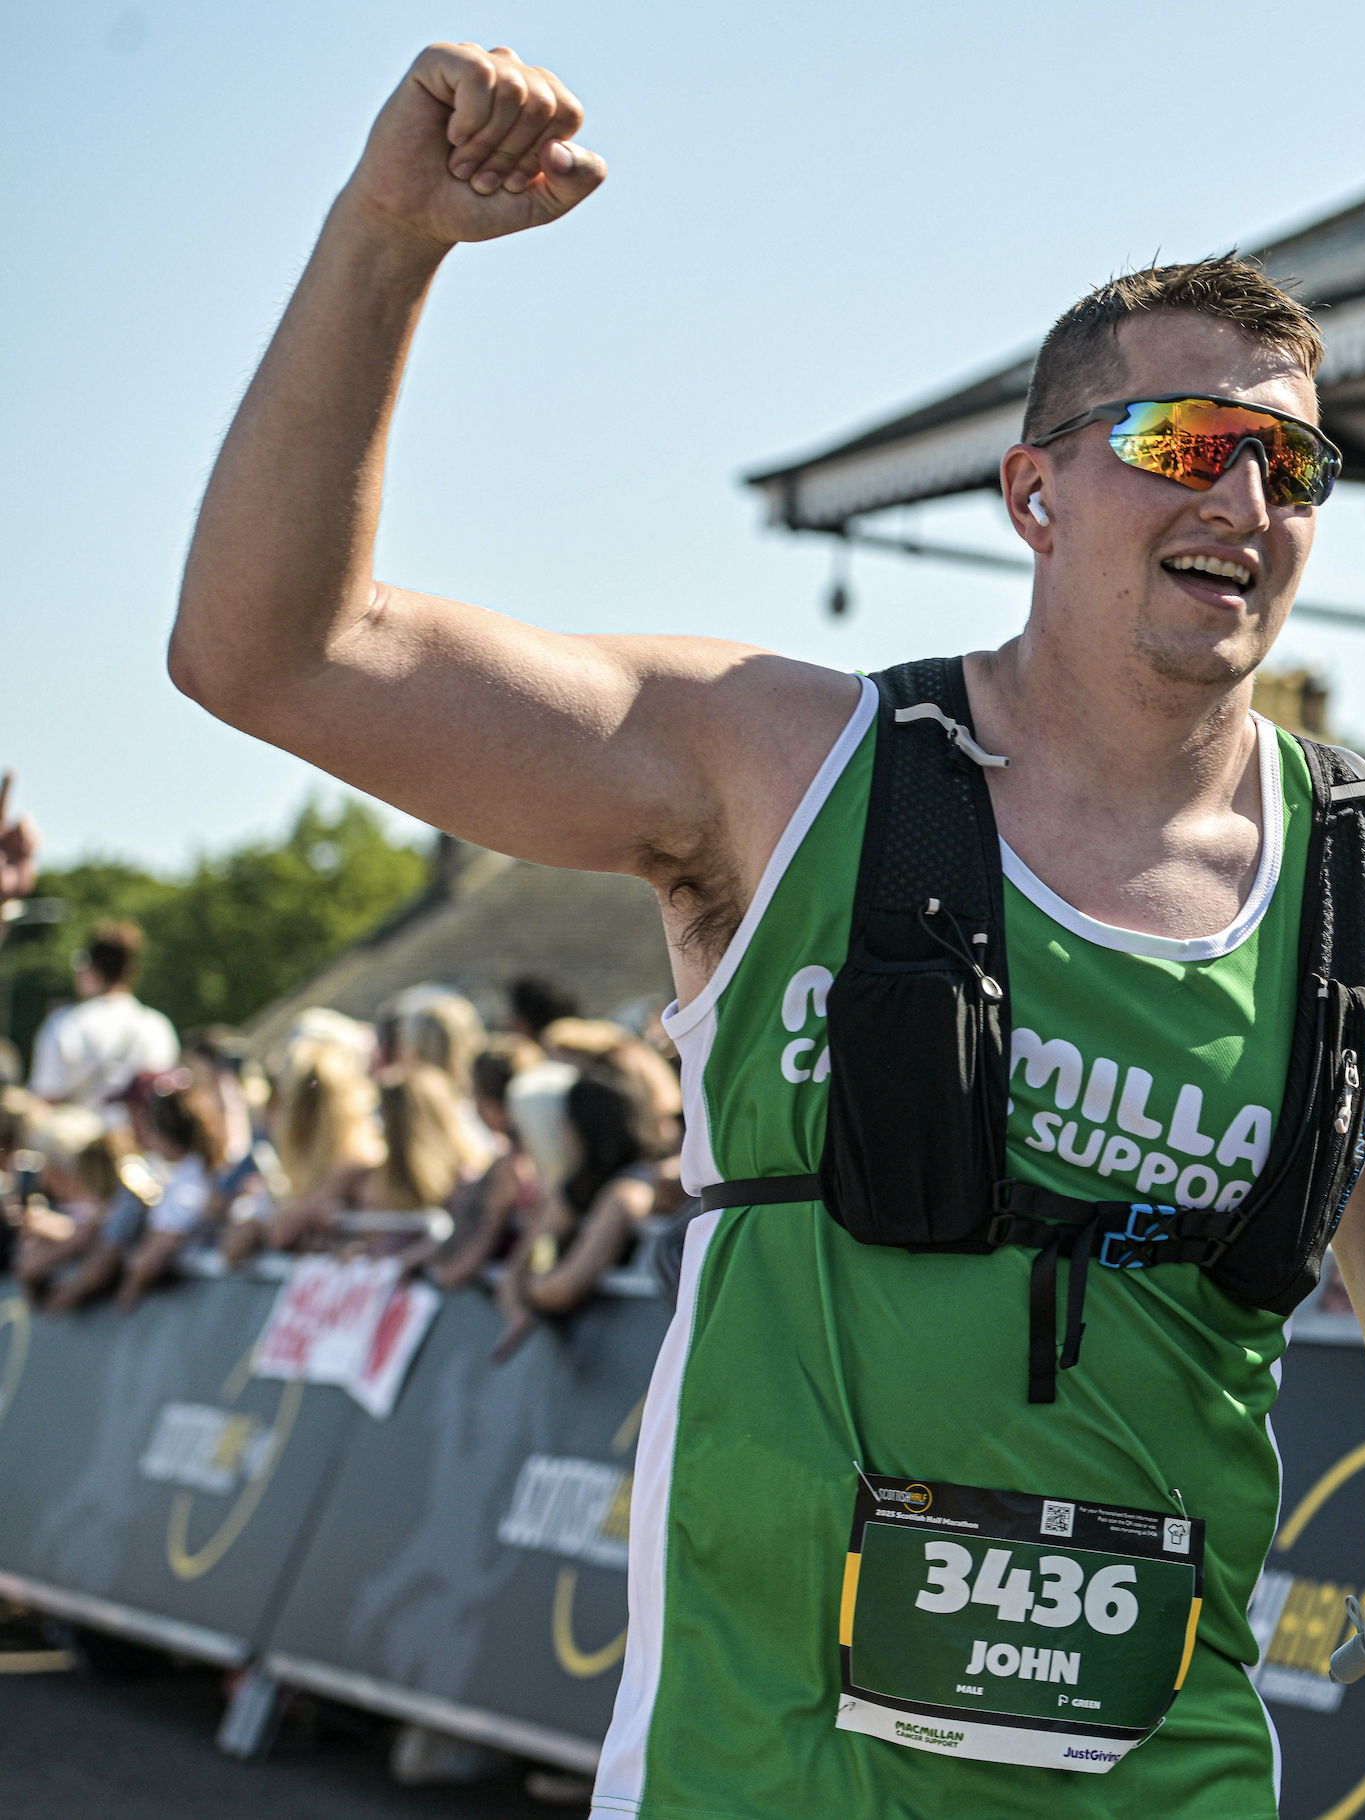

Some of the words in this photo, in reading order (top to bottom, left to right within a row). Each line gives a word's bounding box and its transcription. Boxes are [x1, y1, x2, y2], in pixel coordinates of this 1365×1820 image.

[1025, 1111, 1253, 1212] SUPPOR
[875, 1508, 896, 1518] 2025
[896, 1511, 926, 1522] Scottish
[926, 1515, 942, 1524] Half
[942, 1518, 979, 1529] Marathon
[914, 1540, 1139, 1635] 3436
[965, 1639, 1081, 1685] JOHN
[956, 1684, 984, 1696] MALE
[1071, 1698, 1101, 1710] GREEN
[895, 1720, 964, 1742] MACMILLAN
[896, 1730, 924, 1742] CANCER
[924, 1735, 958, 1748] SUPPORT
[1063, 1747, 1121, 1764] JustGiving
